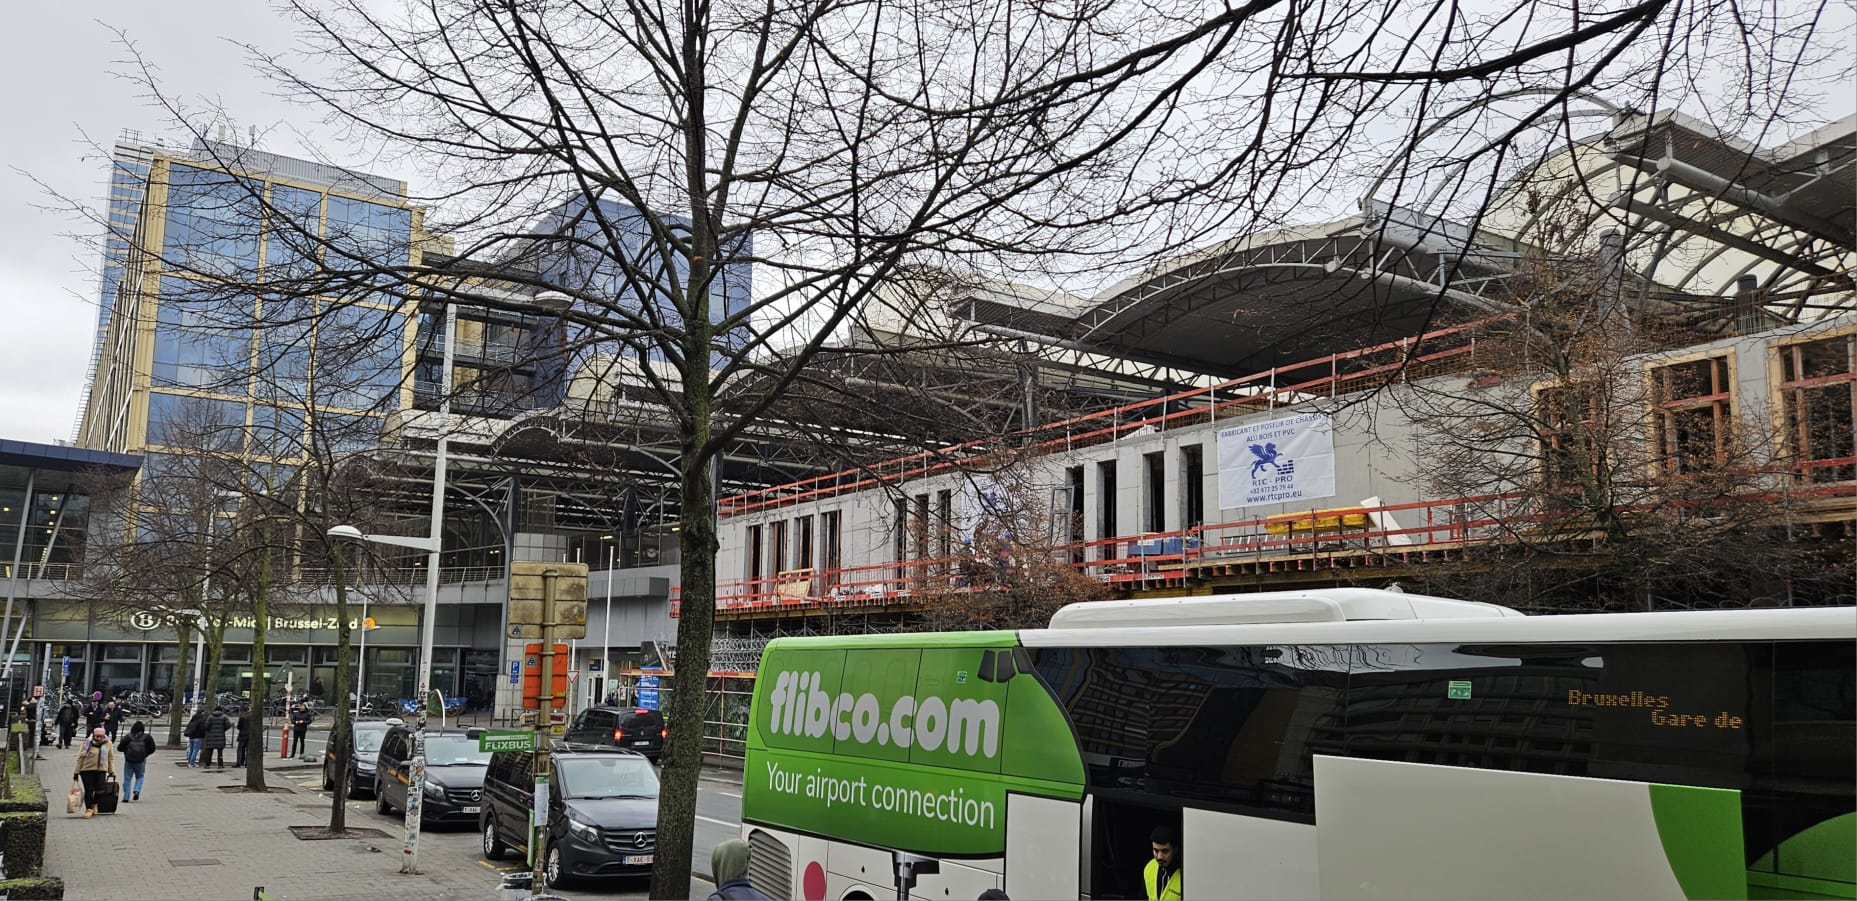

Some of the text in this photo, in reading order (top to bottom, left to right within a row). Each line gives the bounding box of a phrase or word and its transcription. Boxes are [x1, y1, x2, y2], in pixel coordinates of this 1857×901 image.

[1221, 426, 1252, 438] FABRICANT
[1252, 424, 1260, 432] ET
[1260, 421, 1285, 430] POSEUR
[1246, 428, 1295, 443] ALU BOIS ET PVC
[1252, 478, 1268, 487] RTC
[1275, 475, 1293, 484] PRO
[1246, 490, 1302, 503] www.rtcpro.eu
[274, 617, 358, 629] Brussel-Zd
[1568, 689, 1670, 708] Bruxelles
[770, 671, 1000, 758] flibco.com
[1651, 709, 1743, 729] Gare de
[766, 761, 995, 829] Your airport connection
